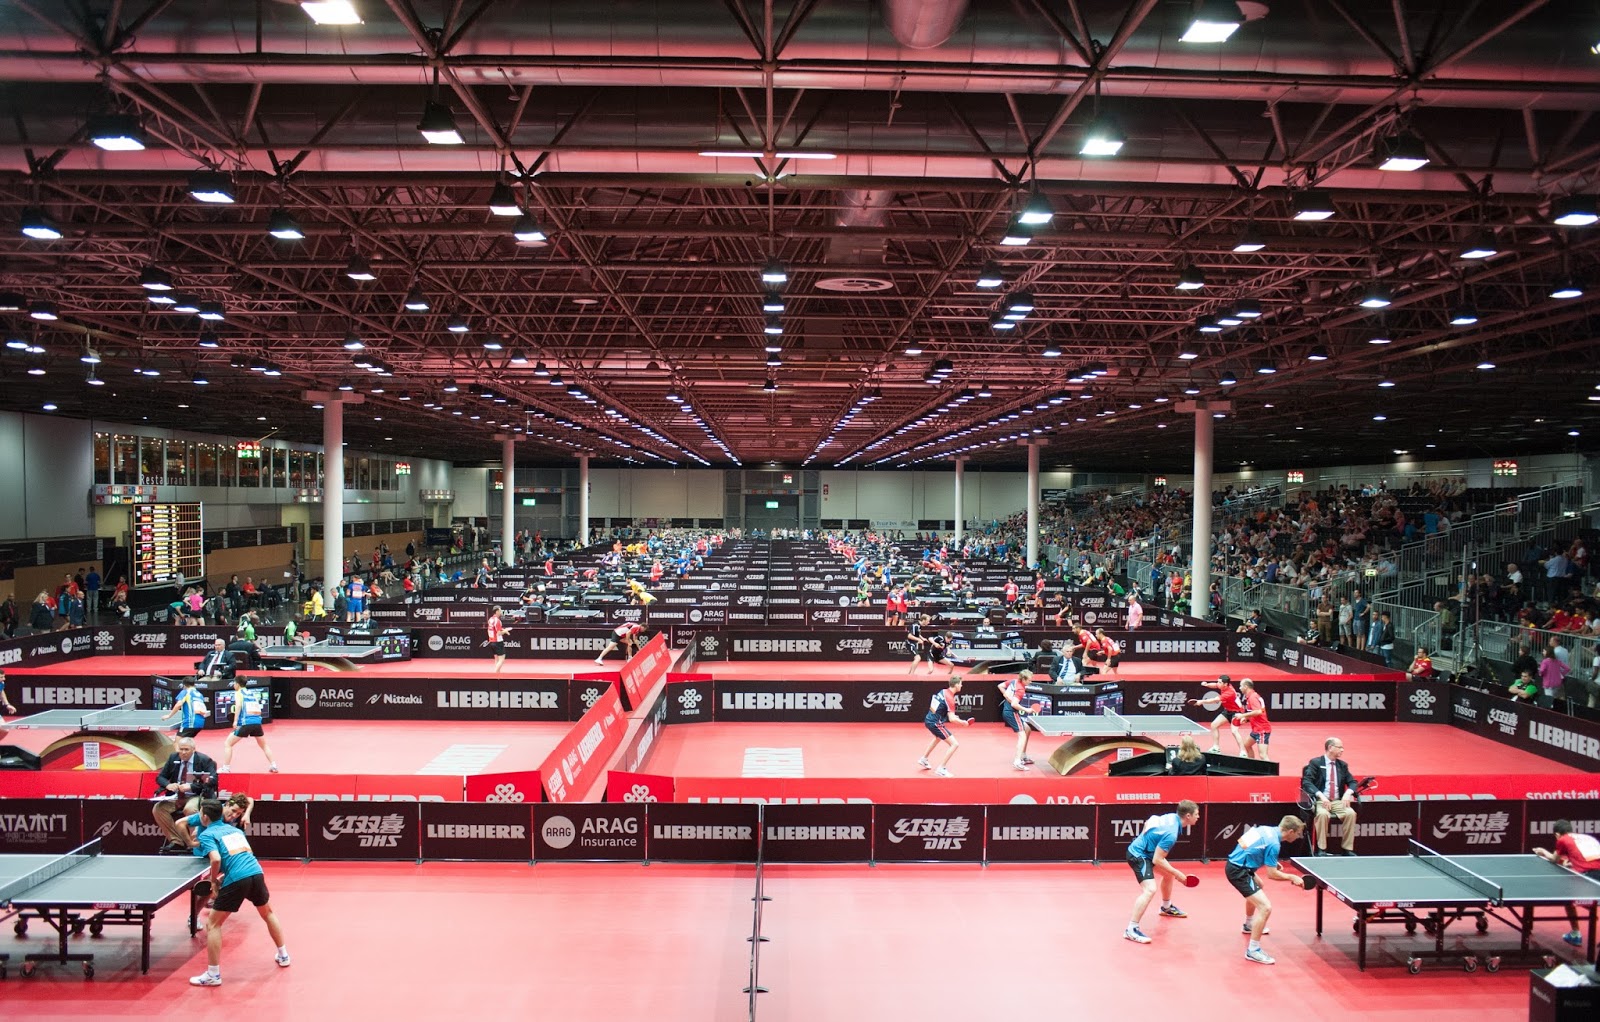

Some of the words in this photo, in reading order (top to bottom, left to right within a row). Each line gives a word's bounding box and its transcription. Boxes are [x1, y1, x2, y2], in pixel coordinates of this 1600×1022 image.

[141, 474, 187, 485] Restaurant
[73, 635, 90, 646] ARAG
[412, 640, 418, 648] 7
[446, 636, 471, 644] ARAG
[530, 638, 618, 650] LIEBHER
[734, 640, 822, 652] LIEBHERR
[1136, 640, 1220, 654] LIEBHERR
[22, 687, 142, 704] LIEBHERR
[274, 692, 282, 703] 7
[320, 688, 354, 700] ARAG
[383, 694, 423, 704] Nittaku
[437, 690, 558, 708] LIEBHERR
[722, 692, 843, 710] LIEBHERR
[865, 691, 914, 705] 红双喜
[1140, 691, 1188, 704] 红双喜
[1271, 692, 1386, 710] LIEBHERR
[884, 704, 912, 712] DHS
[1159, 704, 1186, 712] DHS
[1454, 704, 1478, 719] TISSOT
[1500, 722, 1516, 736] DHS
[1529, 720, 1600, 760] LIEBHER
[123, 820, 164, 836] Nitta
[326, 813, 405, 835] 红双喜
[580, 817, 638, 834] ARAG
[891, 816, 970, 838] 红双喜
[1436, 811, 1510, 832] 红双喜
[248, 822, 300, 837] HERR
[427, 824, 526, 839] LIEBHERR
[546, 826, 572, 837] ARAG
[654, 824, 752, 840] LIEBHERR
[767, 826, 866, 840] LIEBHERR
[992, 826, 1089, 840] LIEBHERR
[358, 834, 402, 847] DHS
[580, 836, 637, 847] Insurance
[923, 838, 967, 850] DHS
[1466, 832, 1506, 844] DHS
